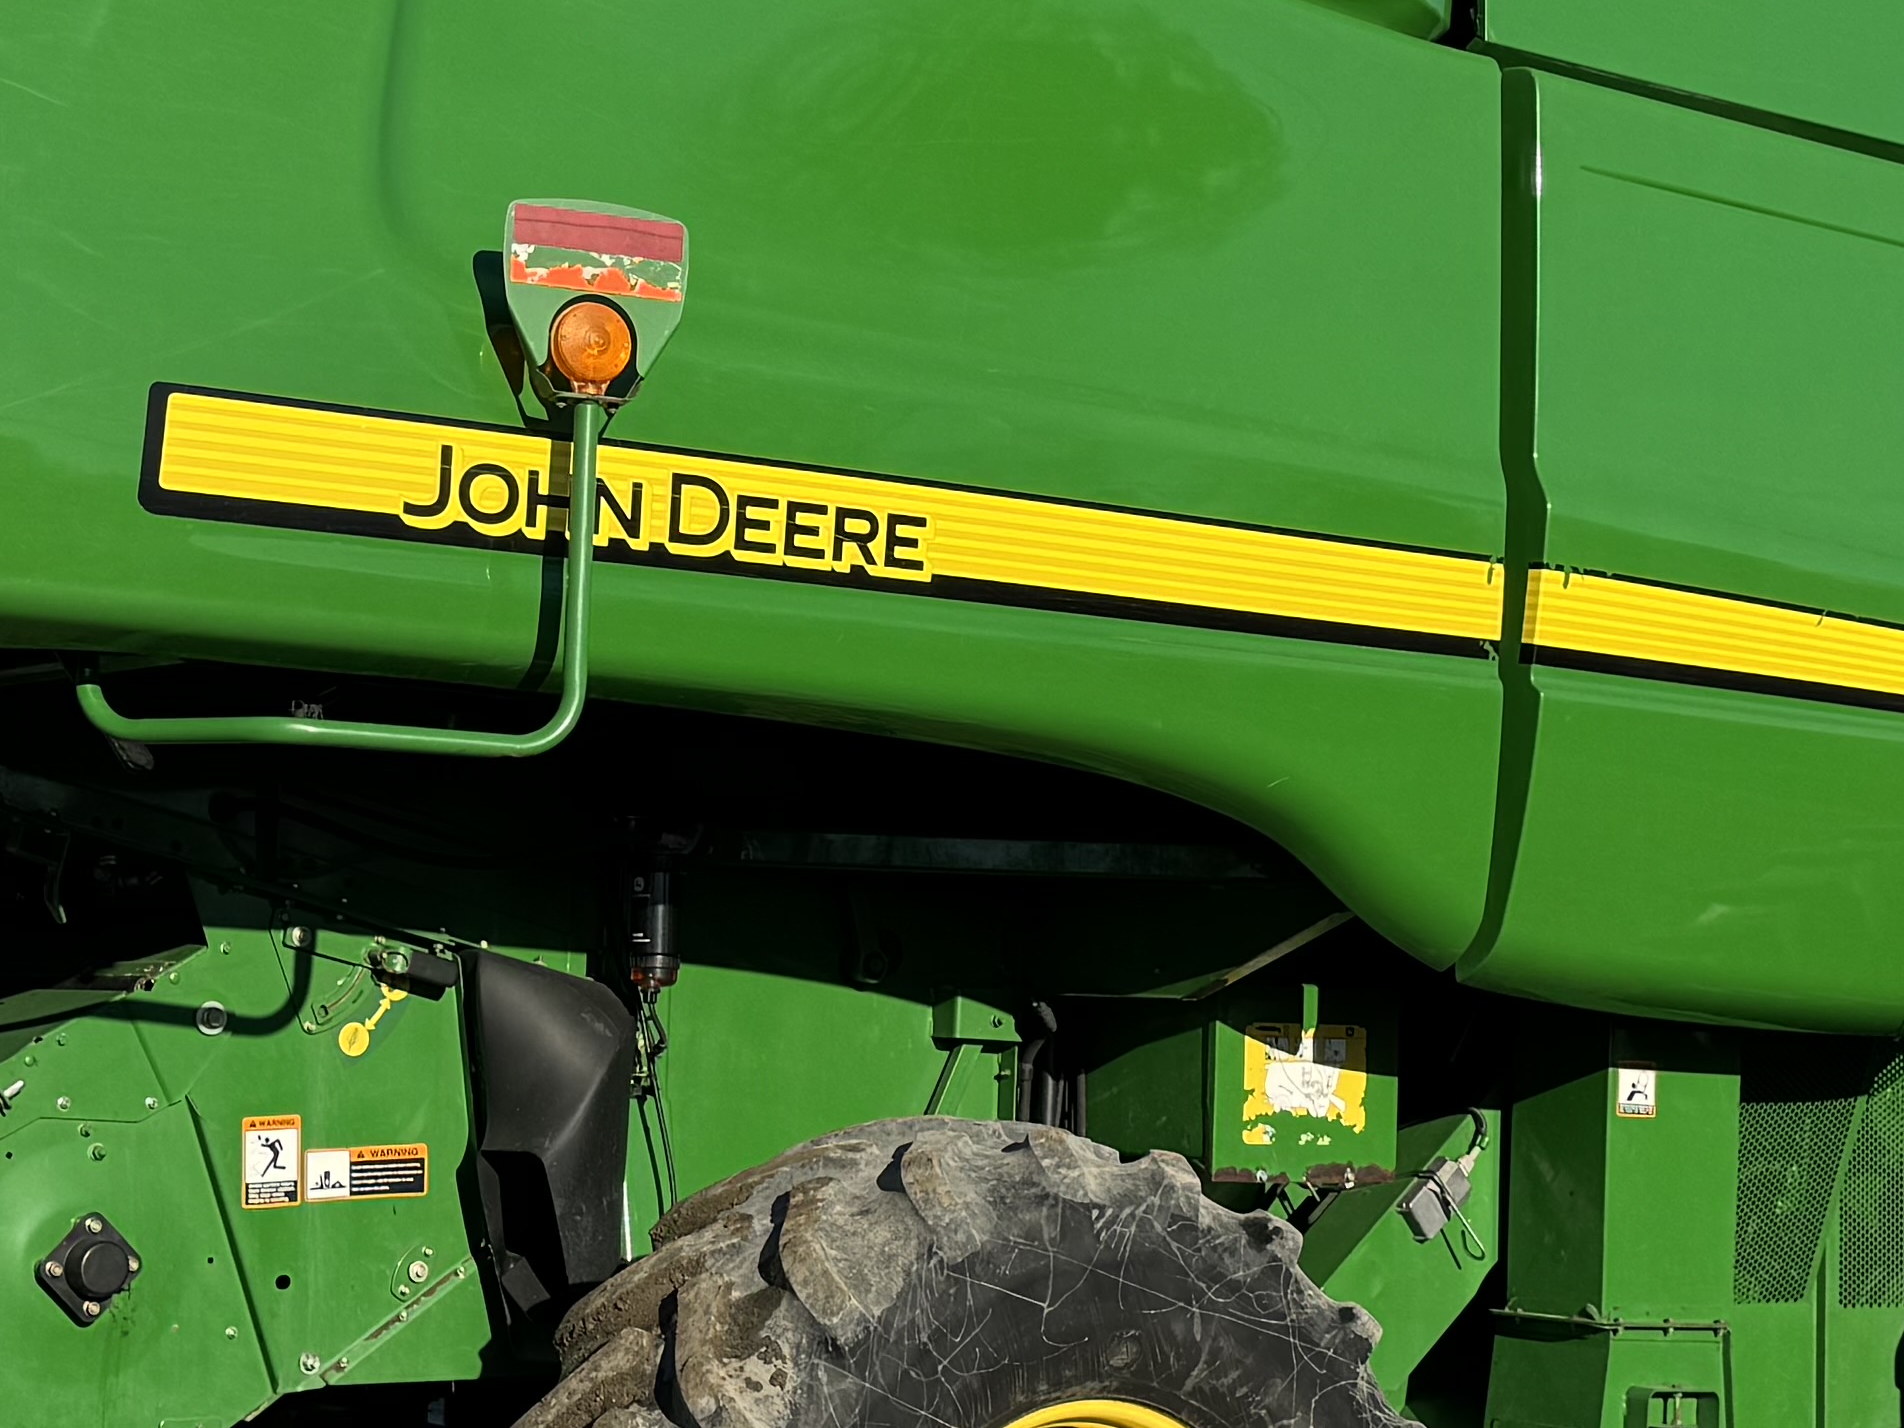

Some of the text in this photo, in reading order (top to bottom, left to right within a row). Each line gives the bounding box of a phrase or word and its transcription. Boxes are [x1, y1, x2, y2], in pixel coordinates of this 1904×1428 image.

[403, 444, 928, 571] JOHN DEERE
[258, 1118, 295, 1128] WARNING
[369, 1147, 419, 1158] WARNING
